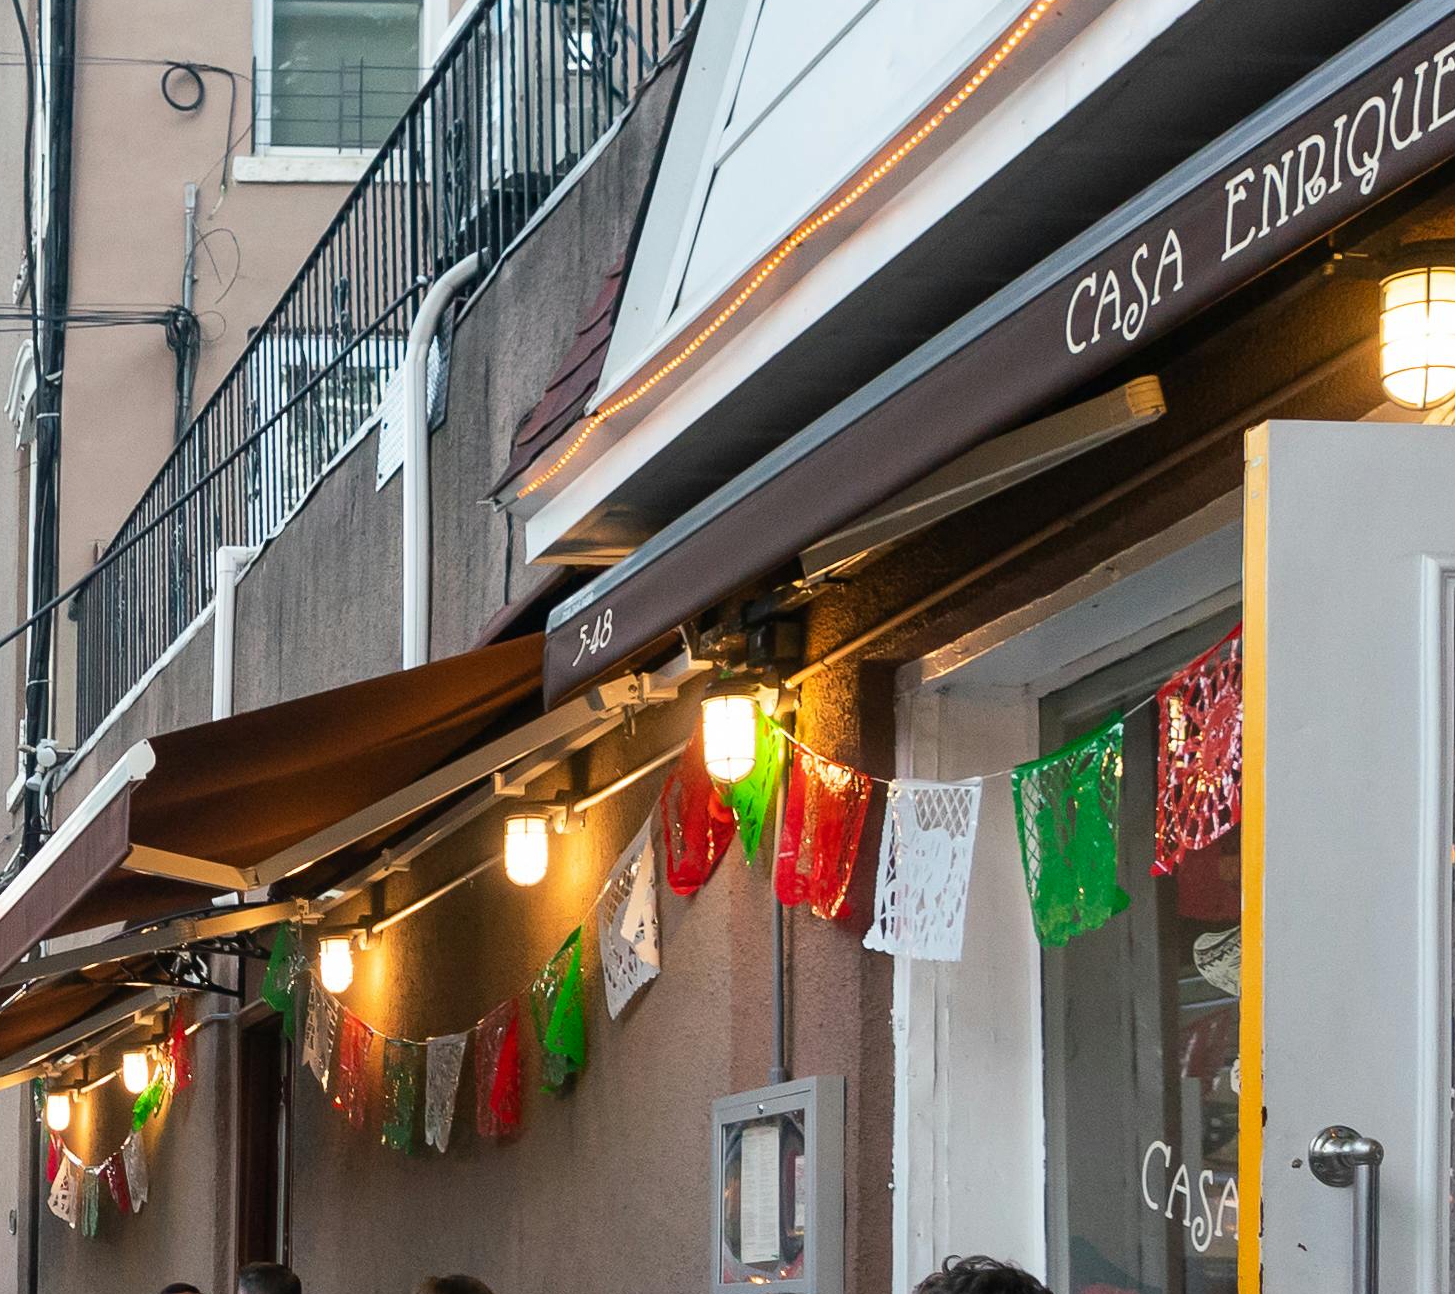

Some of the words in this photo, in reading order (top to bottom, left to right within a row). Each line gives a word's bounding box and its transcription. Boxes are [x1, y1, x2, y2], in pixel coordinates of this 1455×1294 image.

[1065, 228, 1185, 354] CASA
[572, 608, 613, 667] 5-48
[1142, 1140, 1238, 1253] CASA
